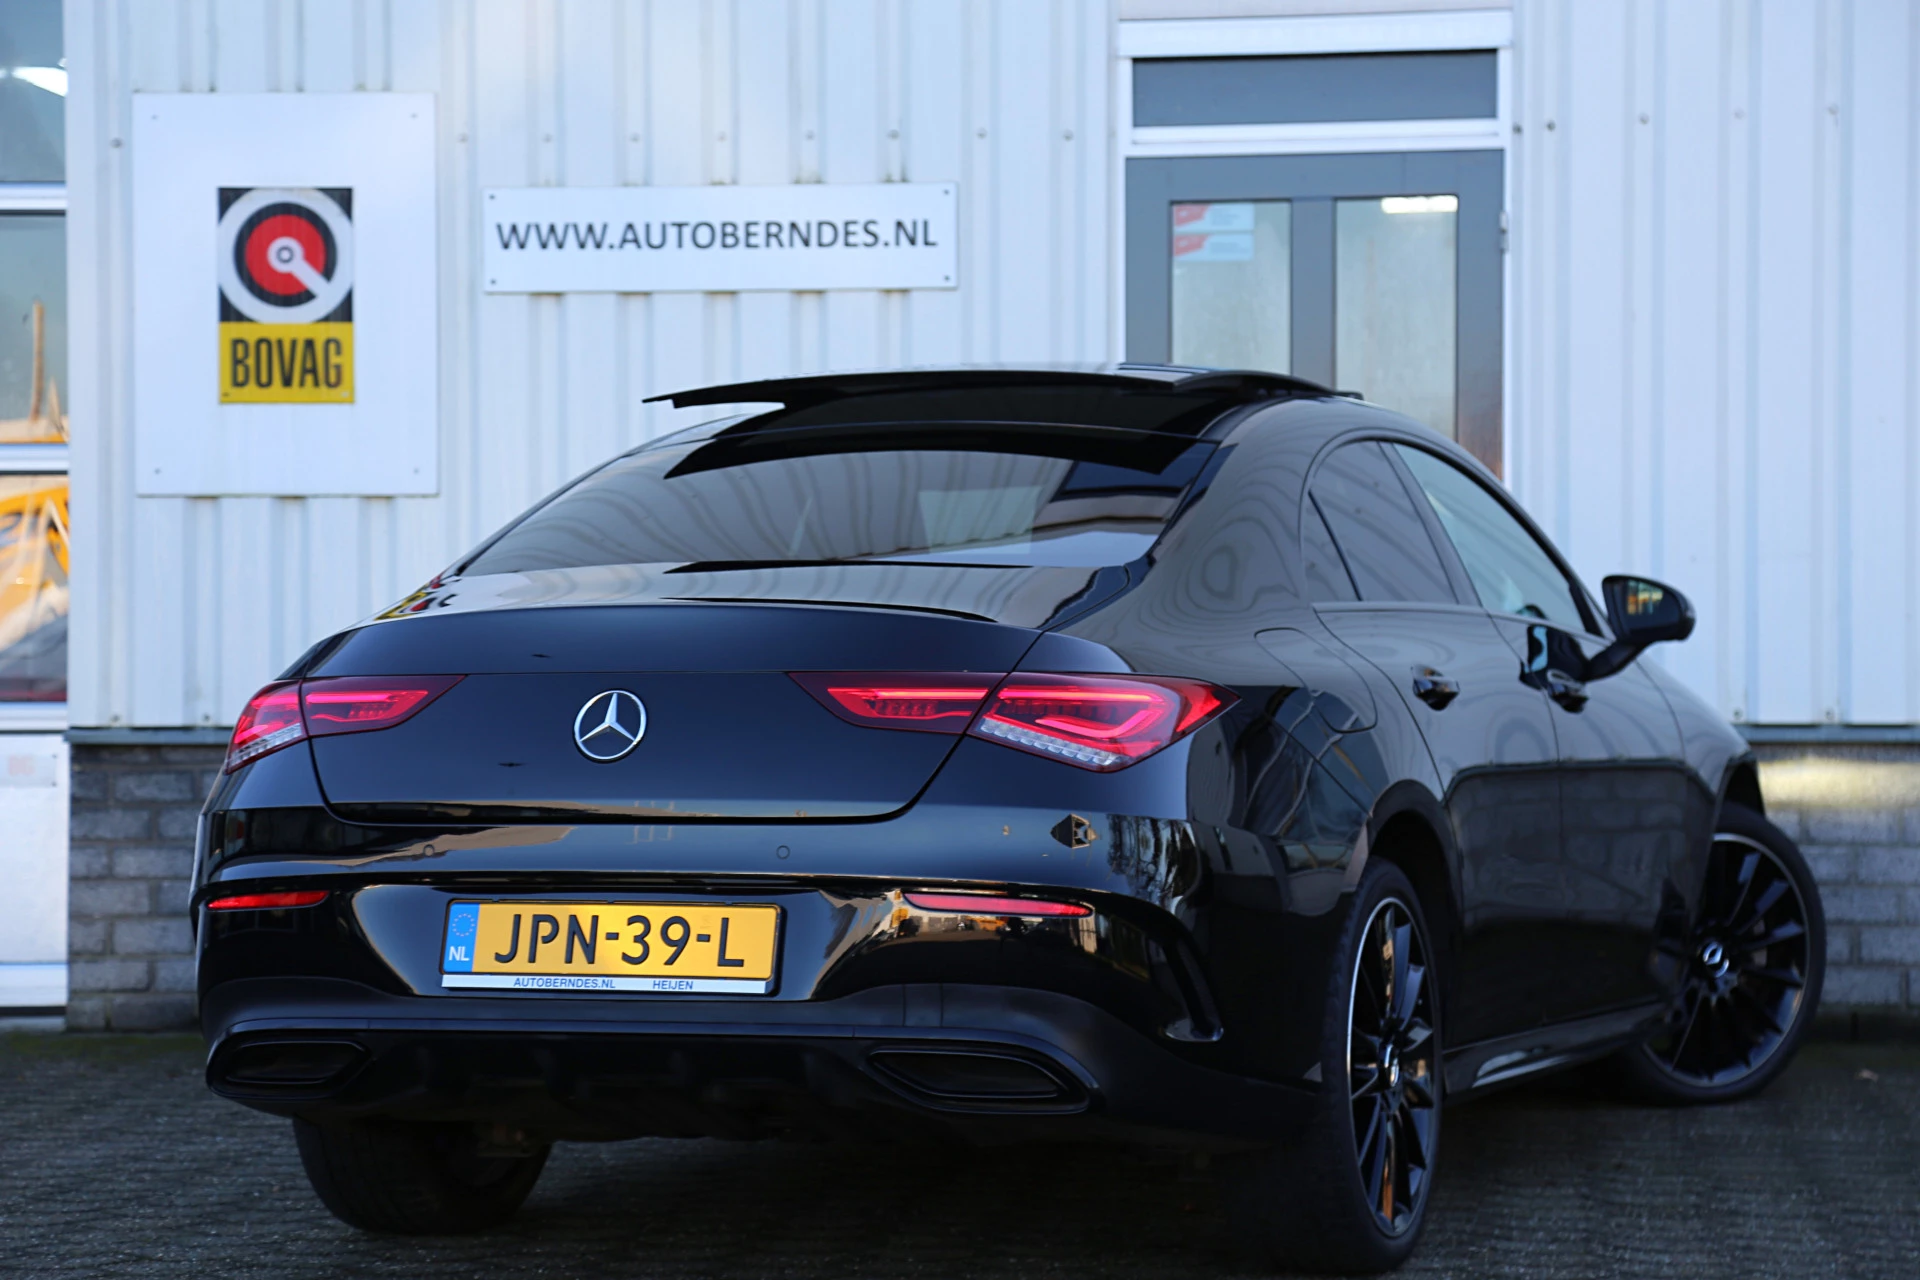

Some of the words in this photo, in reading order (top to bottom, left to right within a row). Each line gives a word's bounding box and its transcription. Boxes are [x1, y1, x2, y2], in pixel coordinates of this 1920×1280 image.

[497, 219, 938, 250] WWW.AUTOBERNDES.NL
[231, 337, 343, 388] BOVAG
[448, 946, 470, 961] NL
[494, 914, 744, 968] JPN-39-L
[513, 977, 616, 989] AUTOBERNDES.NL
[652, 980, 694, 990] HEIJEN
